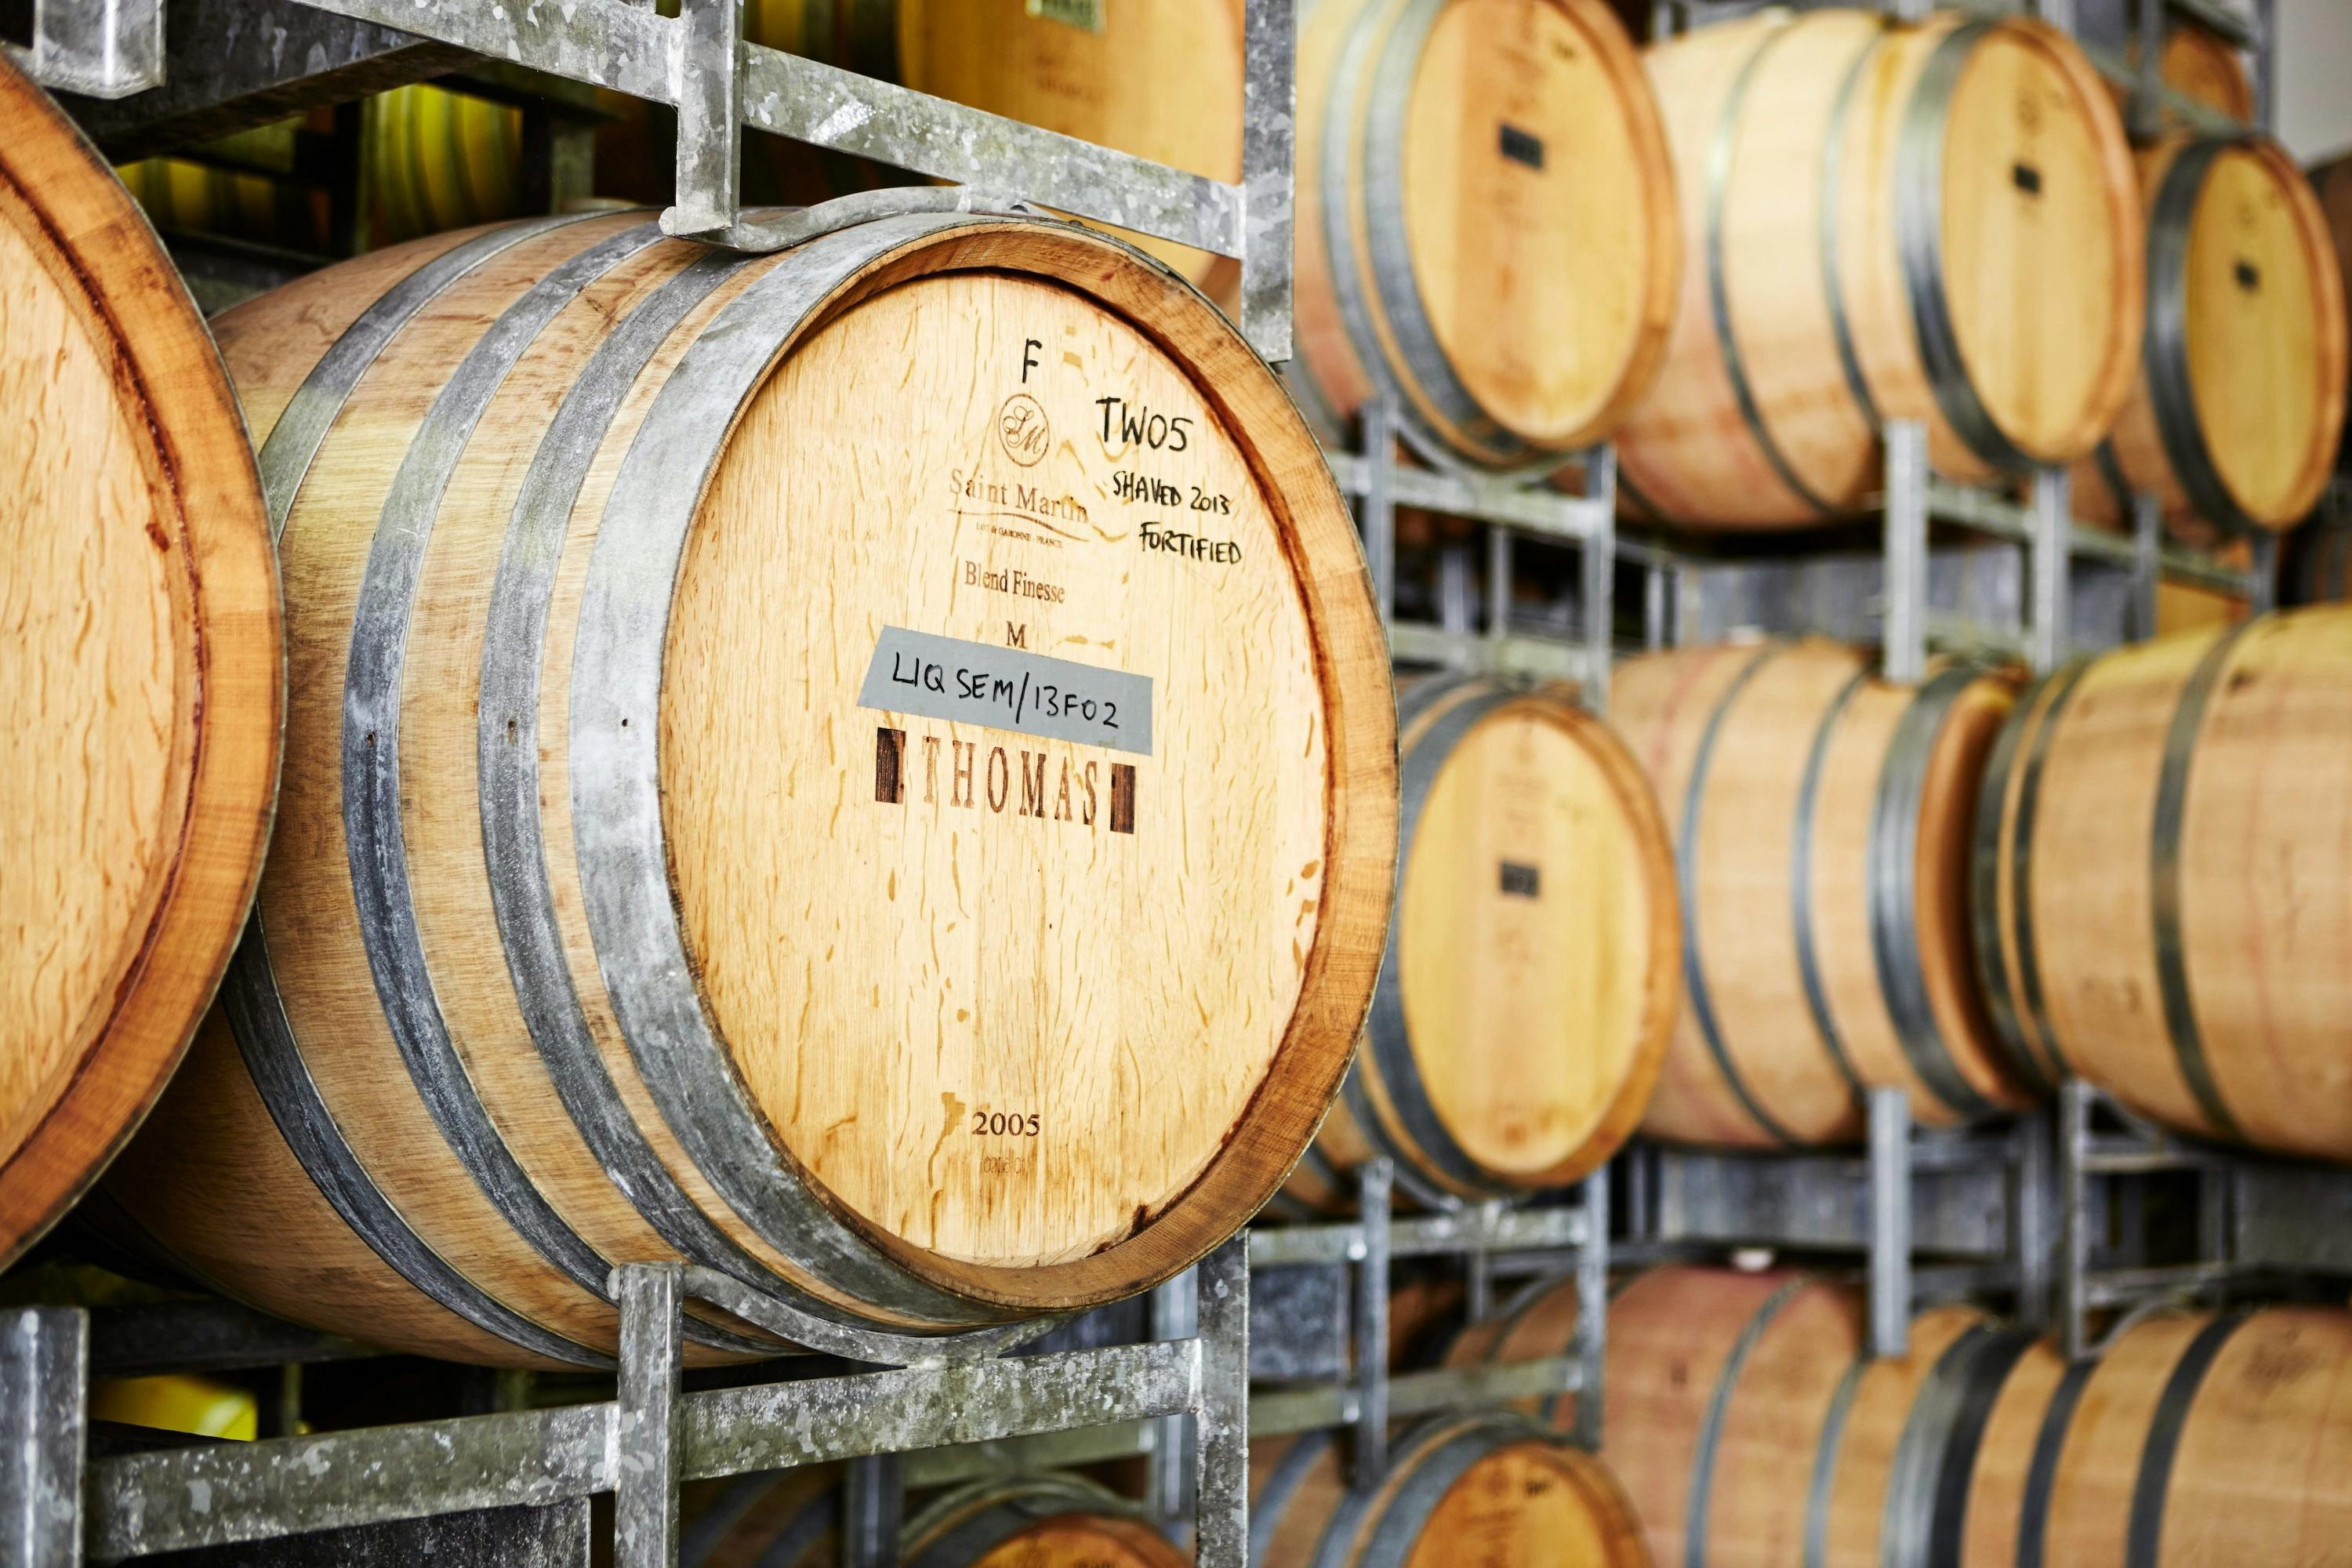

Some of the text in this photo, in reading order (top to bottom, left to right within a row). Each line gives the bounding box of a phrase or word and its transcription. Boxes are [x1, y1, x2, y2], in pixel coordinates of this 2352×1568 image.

[1022, 338, 1042, 383] F
[949, 468, 1090, 523] Saint Martin
[1113, 470, 1230, 515] SHAVED 2013
[1139, 521, 1242, 564] FORTIFIED
[964, 561, 1065, 604] Blend Finesse
[1006, 620, 1029, 649] M
[892, 652, 946, 695] LIQ
[921, 735, 1098, 826] THOMAS
[972, 1112, 1040, 1137] 2005
